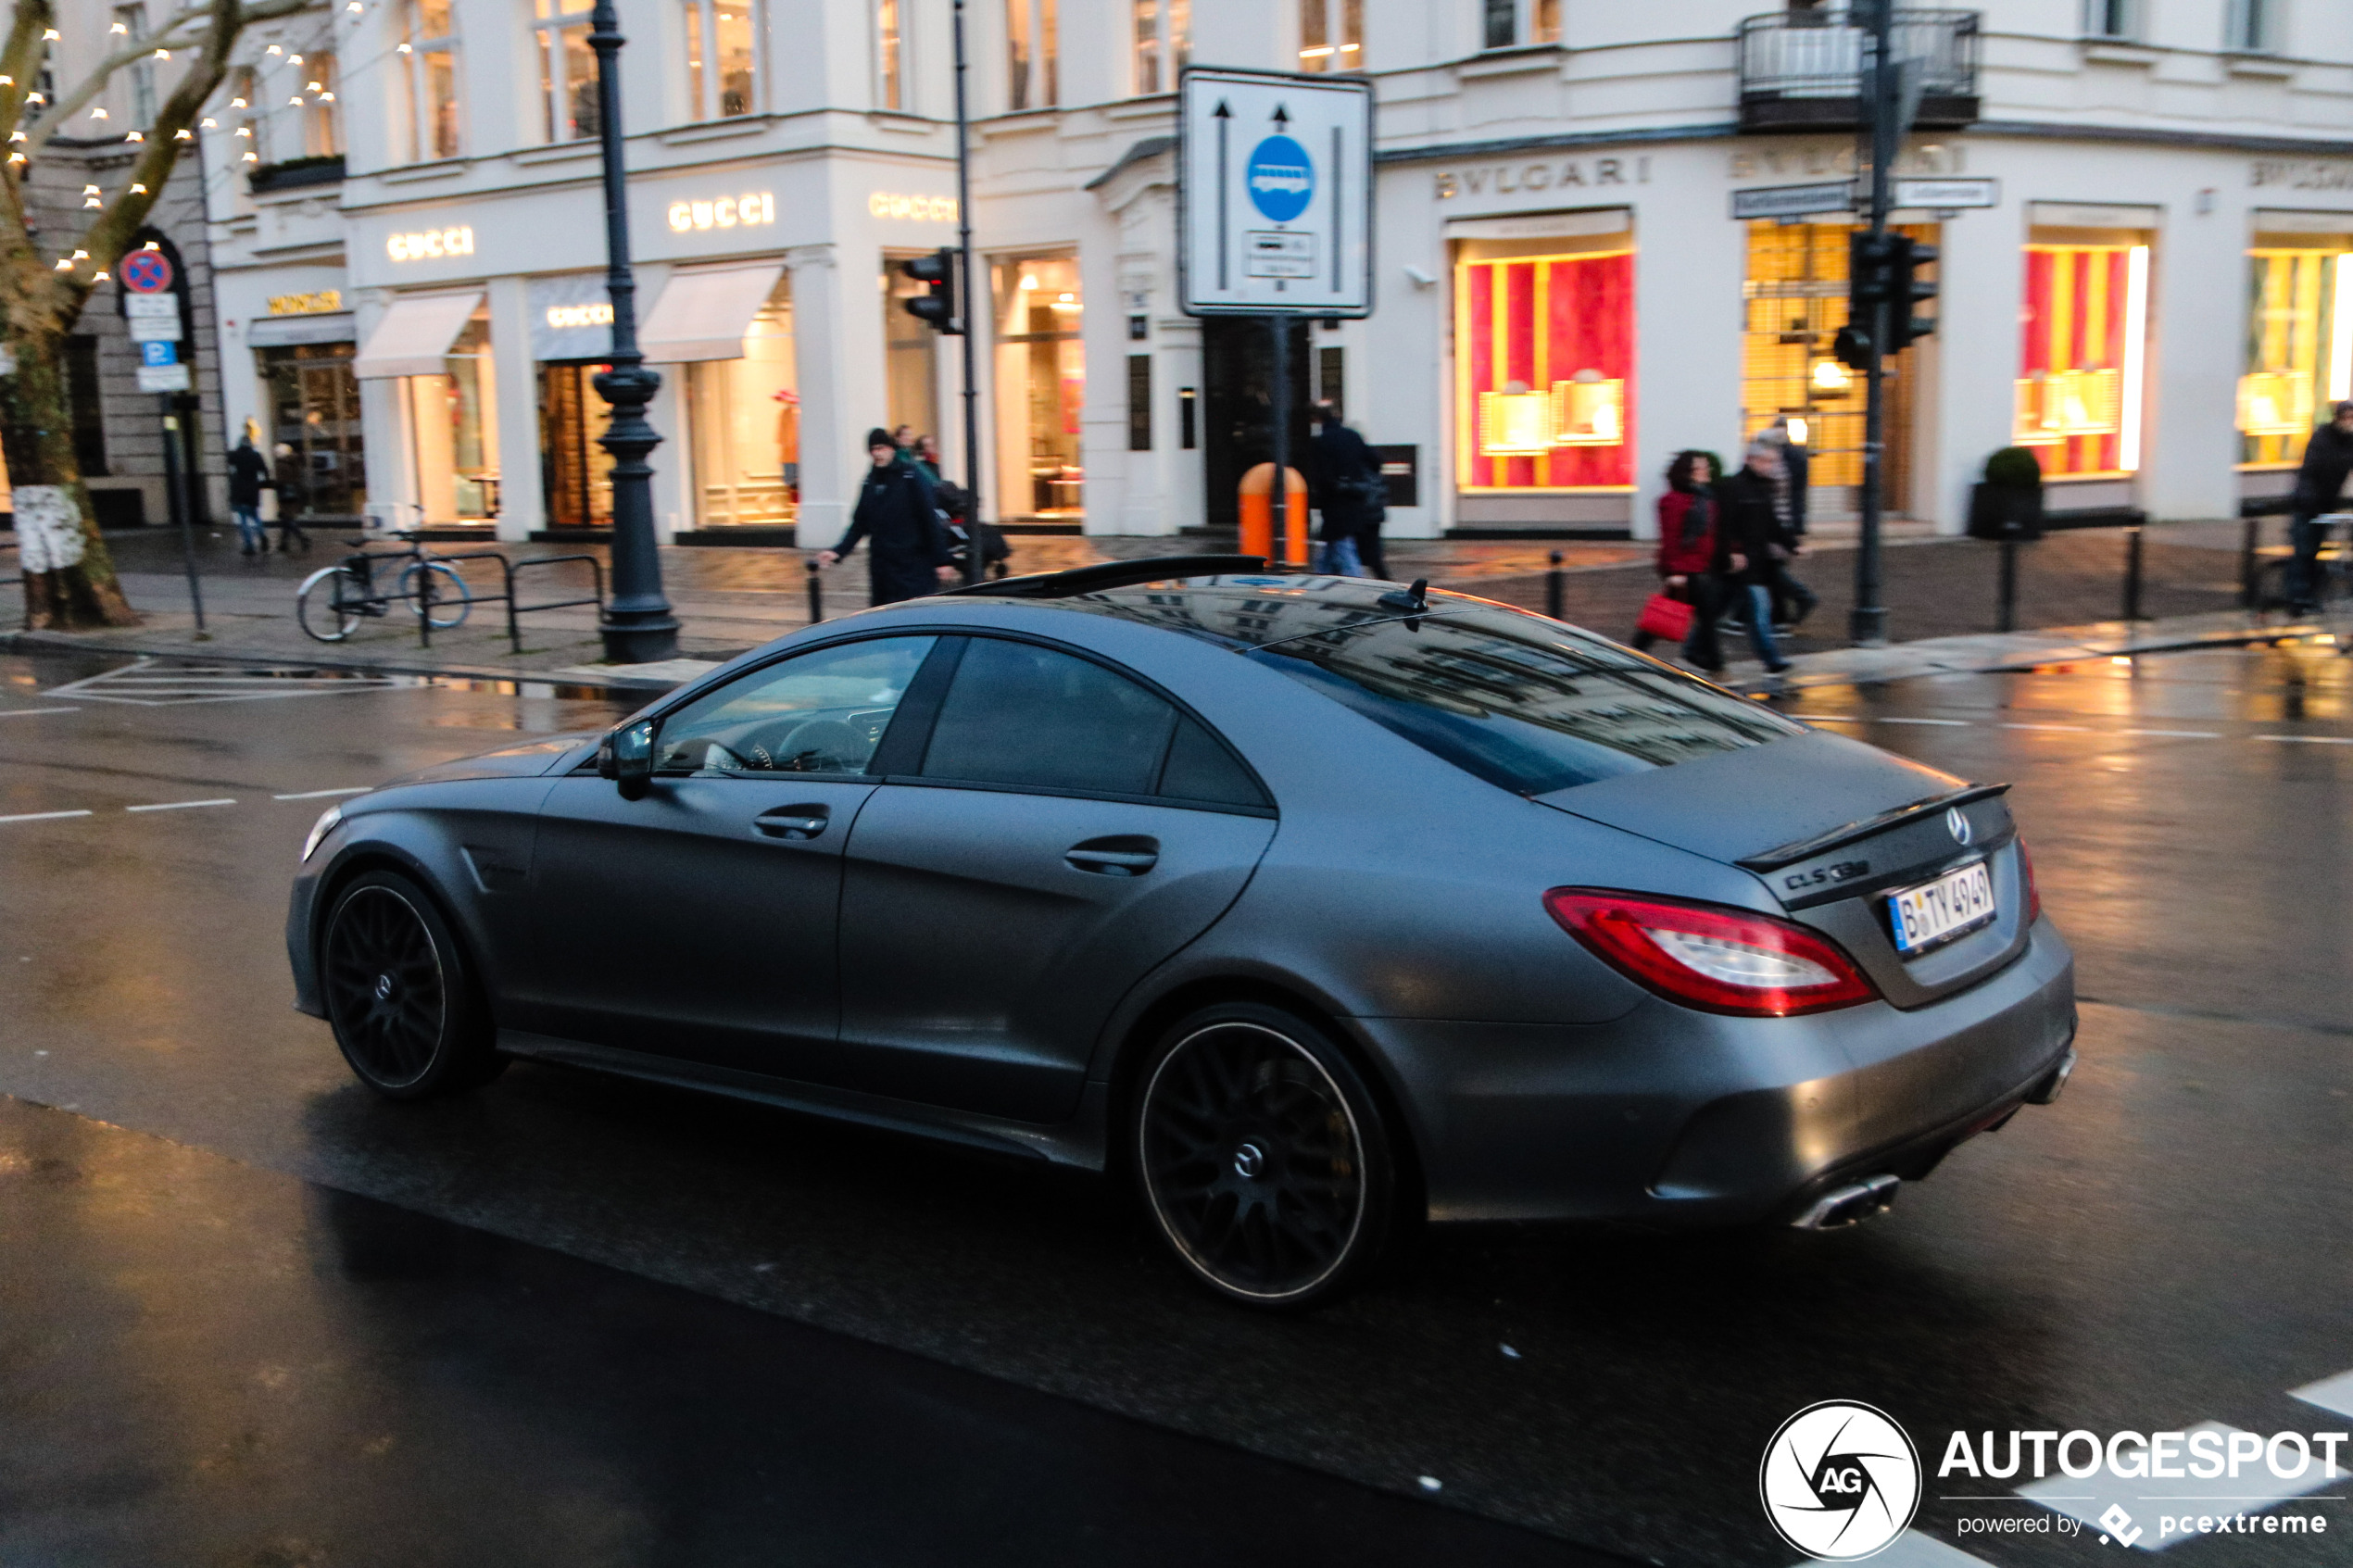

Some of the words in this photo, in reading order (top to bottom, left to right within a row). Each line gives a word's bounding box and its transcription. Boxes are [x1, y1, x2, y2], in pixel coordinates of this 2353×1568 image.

[1434, 154, 1654, 200] BVLGARI
[668, 192, 774, 232] GUCCI
[868, 192, 959, 222] GUCCI
[386, 225, 474, 262] GUCCI
[1784, 868, 1827, 890] CLS
[1901, 898, 1918, 939] B
[1925, 884, 1951, 928] TY
[1952, 870, 1989, 918] 4949
